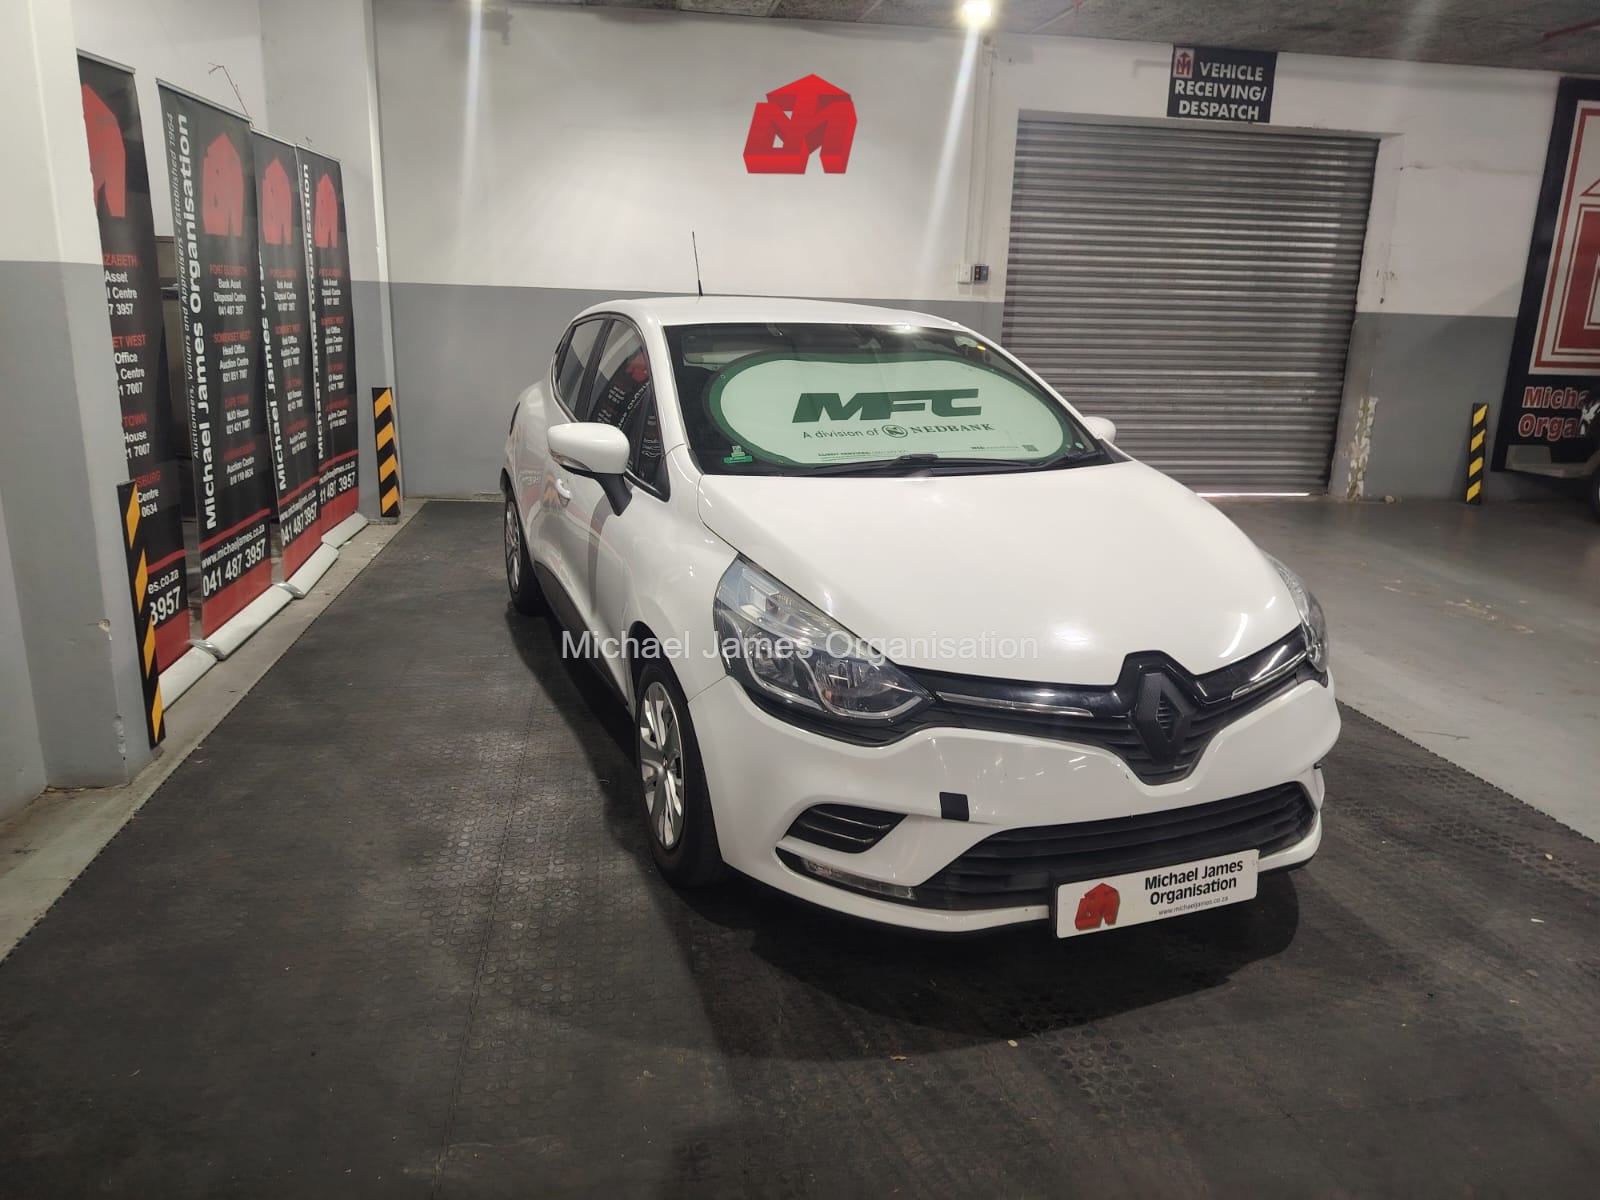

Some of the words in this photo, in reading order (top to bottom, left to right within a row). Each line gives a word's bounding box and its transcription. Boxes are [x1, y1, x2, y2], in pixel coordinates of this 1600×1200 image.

[1200, 62, 1263, 81] VEHICLE
[1175, 80, 1267, 101] RECEIVING/
[1179, 100, 1259, 120] DESPATCH
[178, 114, 202, 314] Organisation
[105, 270, 128, 282] Asset
[112, 287, 138, 298] Centre
[116, 303, 134, 315] 3957
[125, 334, 146, 347] WEST
[114, 352, 138, 364] Office
[262, 317, 276, 394] James
[120, 368, 145, 380] Centre
[193, 322, 210, 414] James
[792, 388, 982, 423] MFC
[124, 430, 147, 443] House
[802, 431, 813, 440] A
[815, 429, 863, 439] division
[866, 428, 880, 437] of
[911, 423, 995, 434] NEDBANK
[270, 400, 287, 490] Michael
[199, 422, 217, 530] Michael
[338, 471, 356, 492] 3957
[137, 488, 159, 503] Centre
[304, 502, 317, 525] 3957
[202, 566, 222, 596] 041
[225, 554, 242, 581] 487
[245, 538, 266, 568] 3957
[1144, 867, 1199, 890] Michael
[1201, 859, 1244, 880] James
[1149, 876, 1237, 906] Organisation
